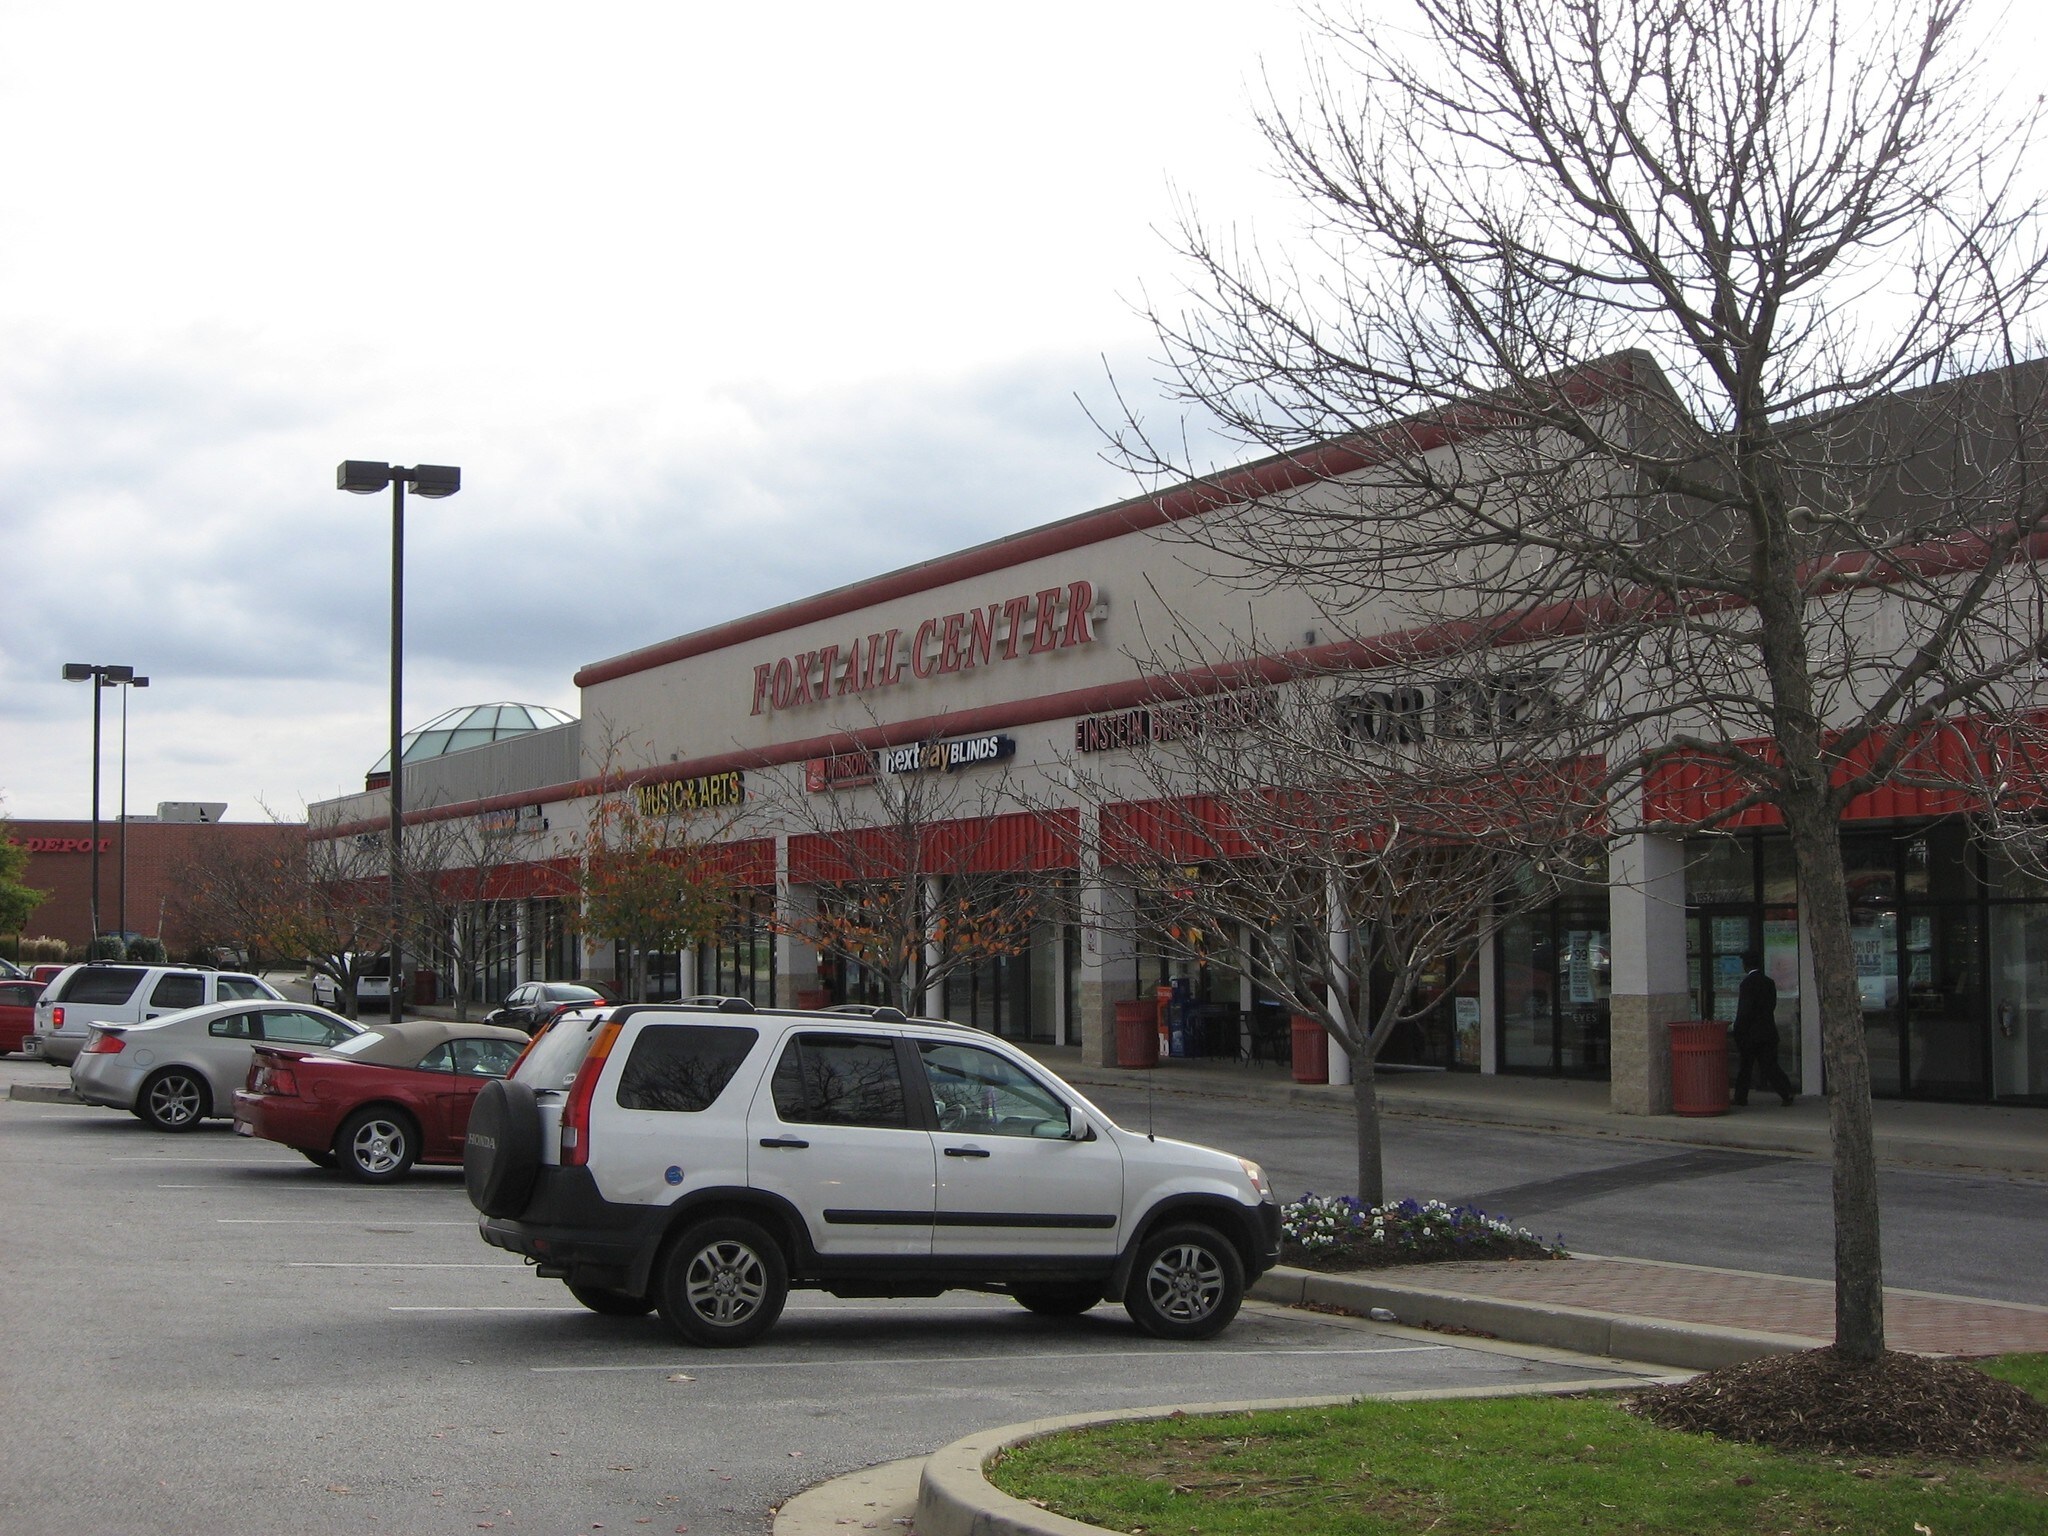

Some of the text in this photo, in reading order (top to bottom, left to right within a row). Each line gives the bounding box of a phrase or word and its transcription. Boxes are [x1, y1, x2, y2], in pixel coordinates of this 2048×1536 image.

[750, 581, 1093, 716] FOXTAIL CENTER
[1075, 710, 1144, 753] EINSTEIN
[826, 752, 878, 780] WINDOW
[638, 780, 683, 816] MUSIC
[700, 771, 740, 808] ARTS
[27, 837, 112, 852] DEPOT
[1866, 941, 1881, 953] OFF
[1856, 954, 1881, 965] ALE
[1573, 1014, 1597, 1022] EYES
[468, 1133, 495, 1149] HONDA
